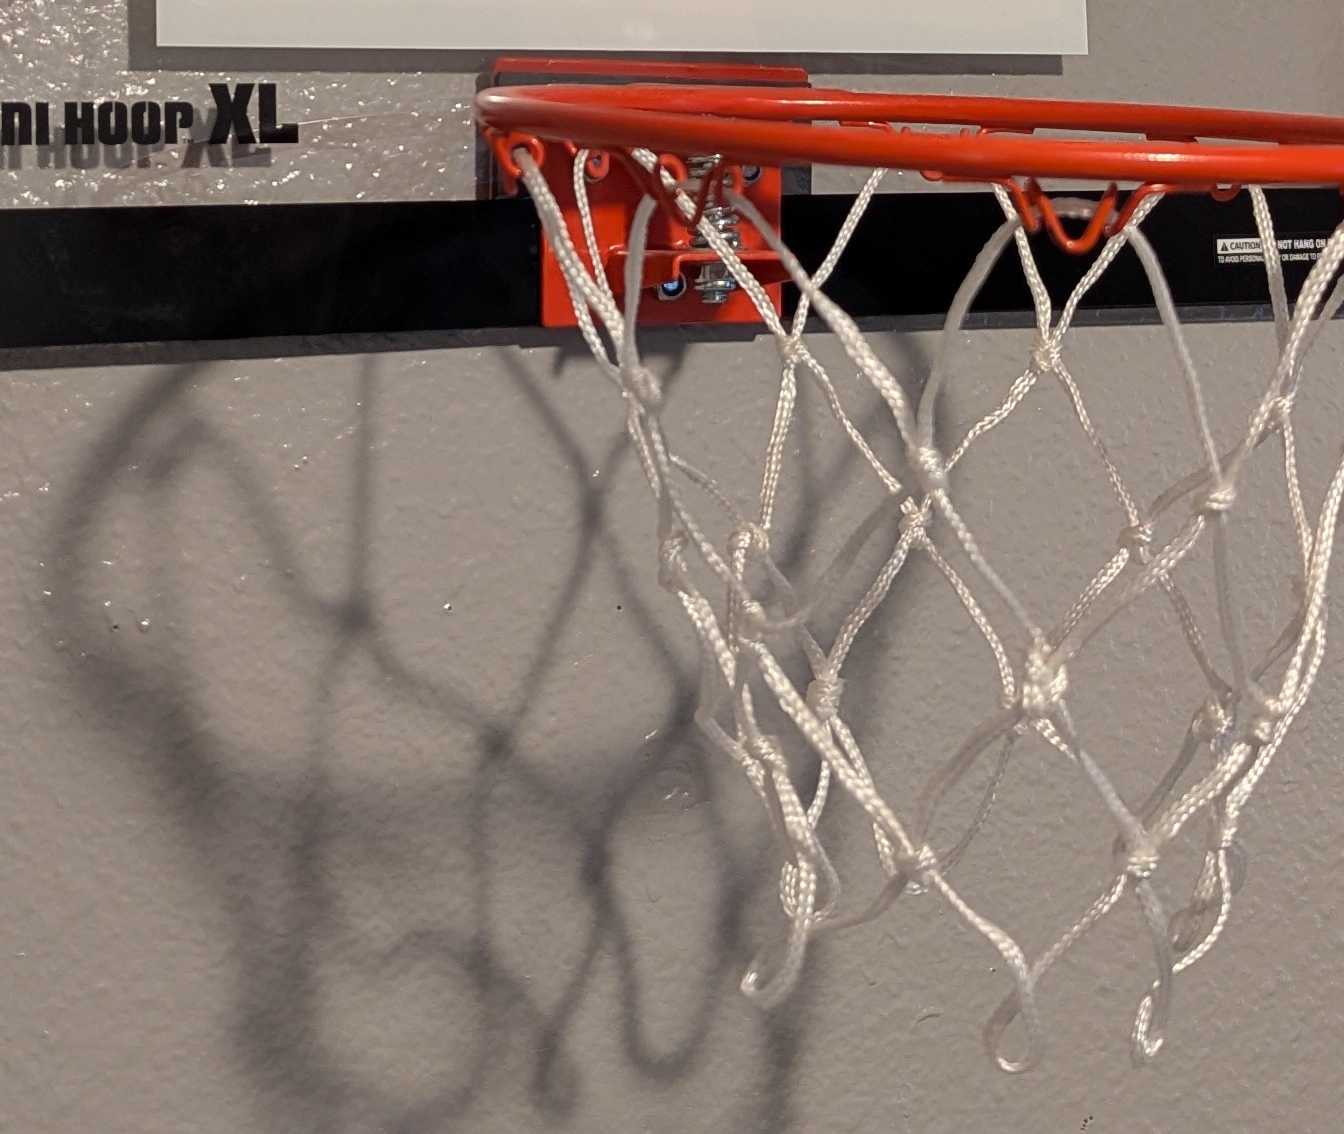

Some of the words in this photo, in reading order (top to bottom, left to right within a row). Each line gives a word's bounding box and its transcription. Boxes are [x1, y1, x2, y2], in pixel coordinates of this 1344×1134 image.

[64, 100, 194, 145] HOOP
[208, 82, 299, 145] XL
[1229, 241, 1261, 251] CAUTION
[1277, 239, 1292, 250] NOT
[1293, 238, 1315, 250] HANG
